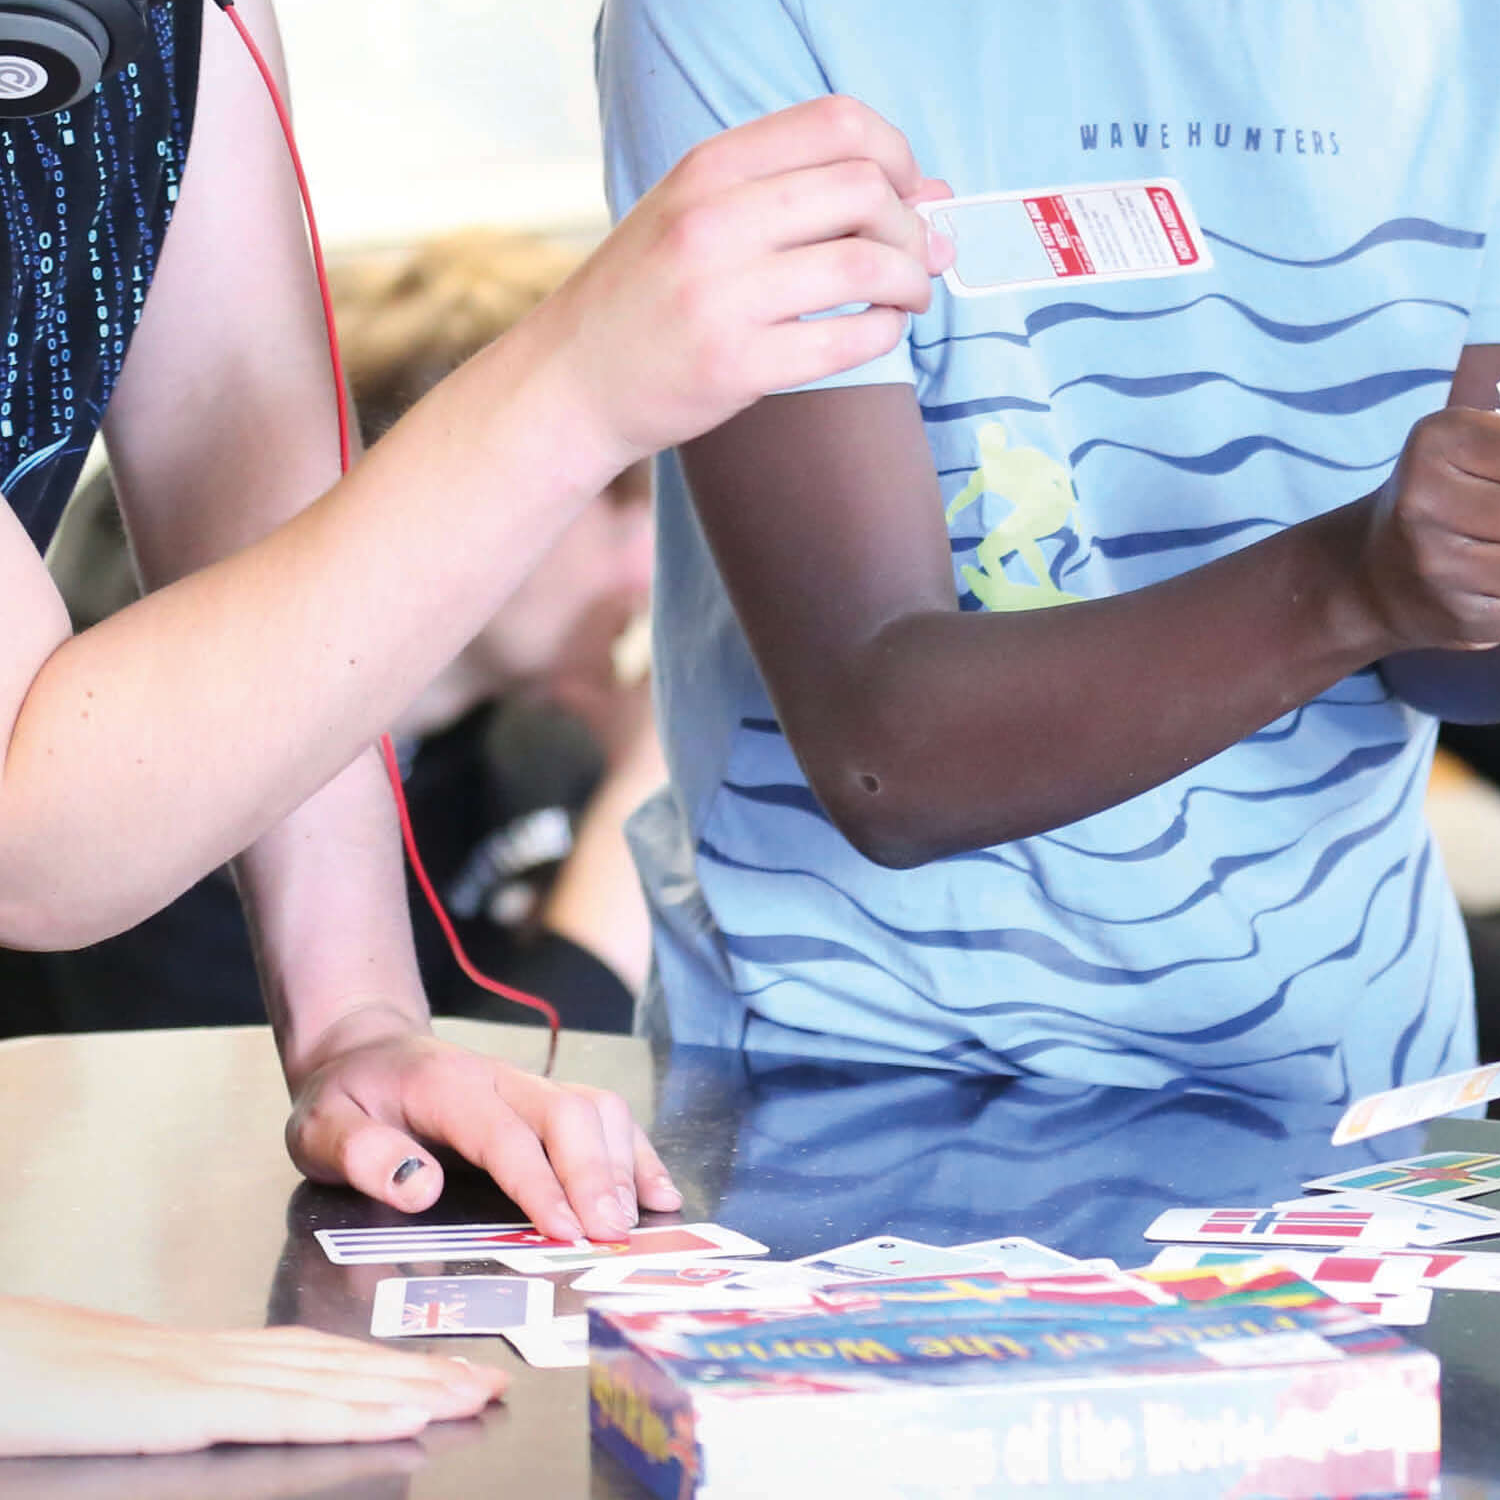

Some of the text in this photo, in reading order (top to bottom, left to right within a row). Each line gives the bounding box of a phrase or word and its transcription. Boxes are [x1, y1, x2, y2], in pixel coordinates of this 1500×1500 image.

[1080, 121, 1340, 155] WAVE HUNTERS
[906, 1333, 1031, 1361] the
[1059, 1397, 1134, 1482] the
